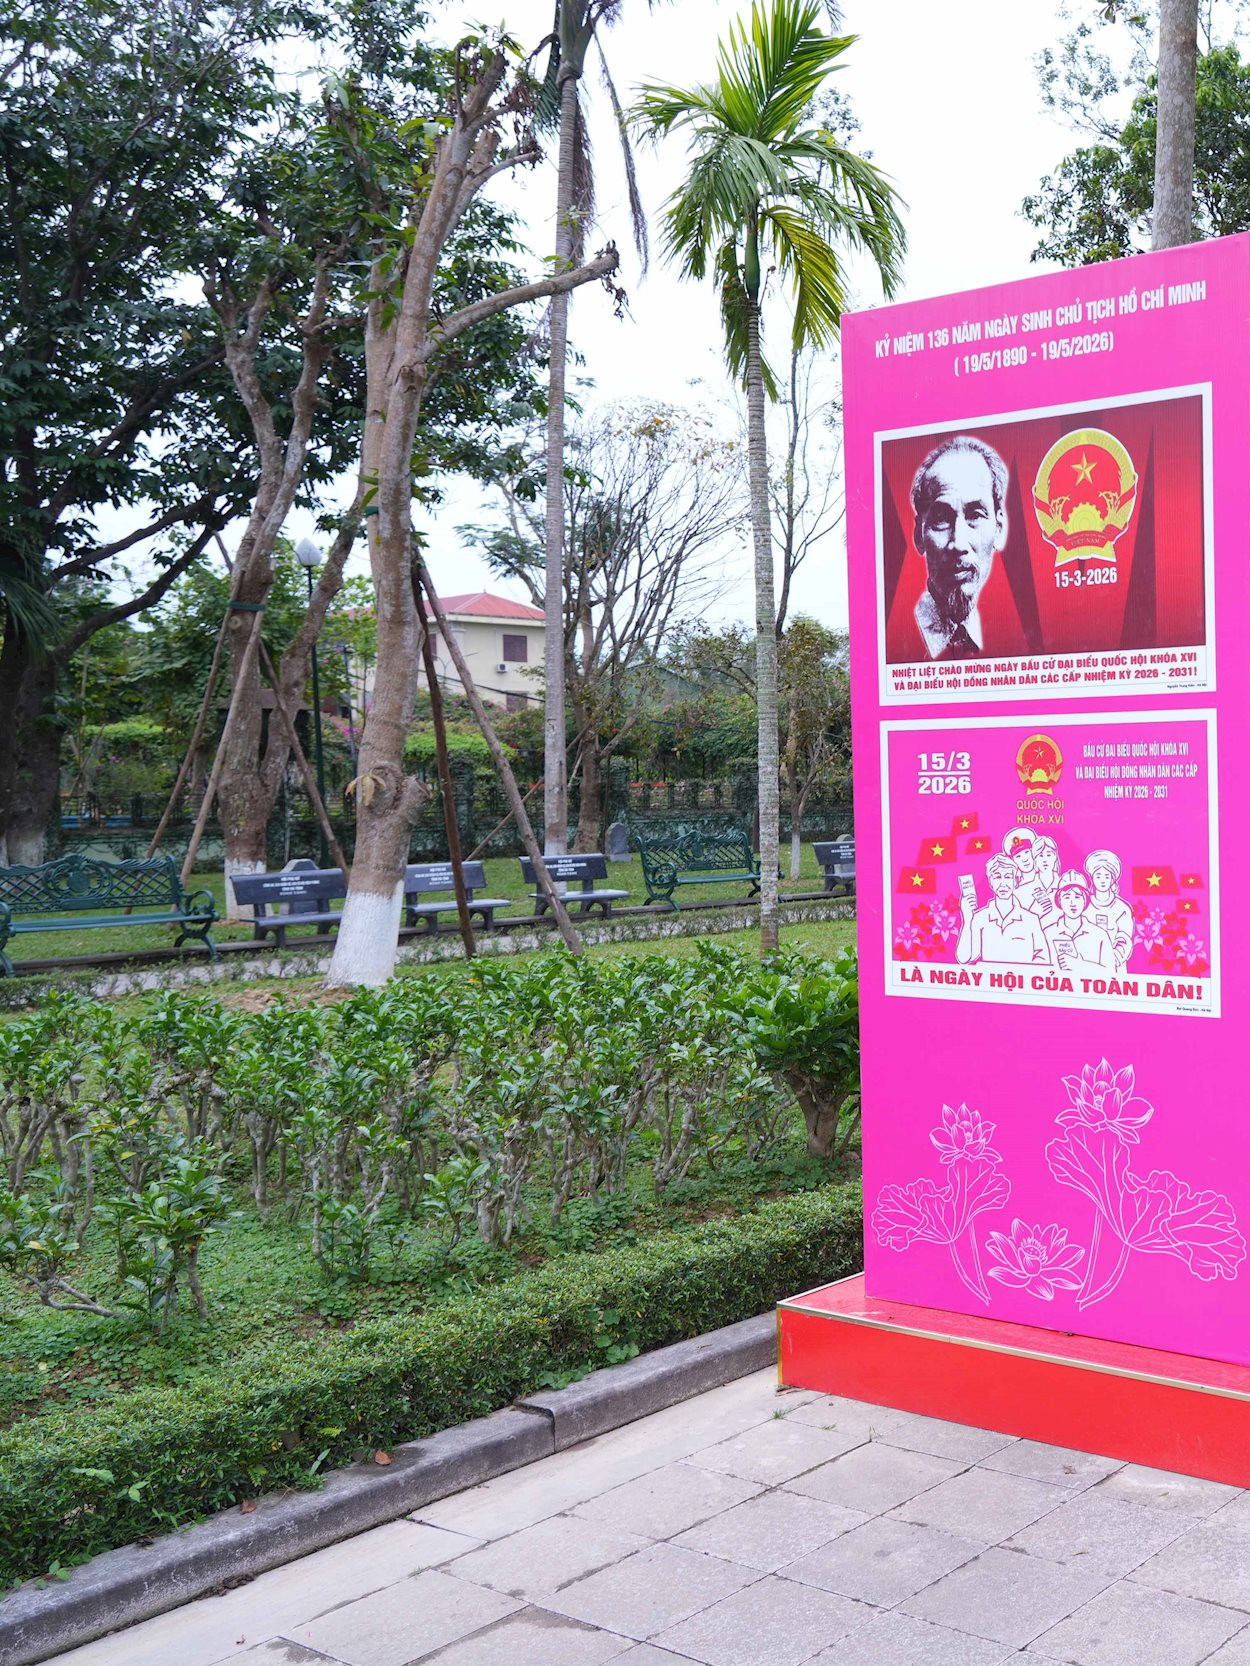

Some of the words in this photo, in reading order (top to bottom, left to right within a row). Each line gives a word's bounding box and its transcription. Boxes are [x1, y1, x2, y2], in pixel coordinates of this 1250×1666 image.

[875, 334, 890, 358] KỶ
[893, 332, 924, 357] NIỆM
[927, 328, 949, 350] 136
[952, 320, 981, 345] NĂM
[985, 314, 1017, 339] NGÀY
[1021, 309, 1052, 332] SINH
[1056, 298, 1082, 326] CHỦ
[1087, 298, 1115, 323] TỊCH
[1119, 286, 1137, 316] HỒ
[1141, 284, 1164, 311] CHÍ
[1168, 280, 1206, 307] MINH
[963, 346, 1027, 374] 19/5/1890
[1041, 331, 1114, 361] 19/5/2026)
[1055, 567, 1117, 587] 15-3-2026
[892, 668, 916, 678] NHIỆT
[919, 666, 936, 677] LIỆT
[939, 663, 962, 675] CHÀO
[965, 662, 991, 674] MỪNG
[994, 661, 1018, 672] NGÀY
[1021, 658, 1039, 671] BẦU
[1043, 657, 1056, 670] CỬ
[1058, 659, 1073, 671] ĐẠI
[1077, 654, 1098, 668] BIỂU
[1101, 653, 1127, 667] QUỐC
[1131, 654, 1147, 667] HỘI
[1150, 652, 1177, 664] KHÓA
[1181, 652, 1197, 662] XVI
[895, 680, 905, 691] VÀ
[908, 680, 921, 692] ĐẠI
[924, 677, 943, 689] BIỂU
[947, 677, 961, 690] HỘI
[964, 675, 987, 688] ĐỒNG
[991, 675, 1016, 686] NHÂN
[1019, 674, 1038, 684] DÂN
[1041, 672, 1059, 683] CÁC
[1063, 669, 1081, 683] CẤP
[1084, 670, 1116, 683] NHIỆM
[1119, 668, 1131, 680] KỲ
[1135, 669, 1158, 679] 2026
[1169, 666, 1197, 677] 2031!
[1083, 741, 1095, 758] BẦU
[1096, 740, 1105, 757] CỬ
[1106, 744, 1116, 760] ĐẠI
[1117, 739, 1130, 756] BIỂU
[1132, 741, 1148, 758] QUỐC
[1149, 740, 1160, 759] HỘI
[1161, 740, 1177, 756] KHÓA
[1179, 742, 1188, 756] XVI
[917, 751, 971, 771] 15/3
[1076, 763, 1084, 779] VÀ
[1085, 766, 1094, 781] ĐẠI
[1096, 761, 1109, 778] BIỂU
[1110, 763, 1120, 782] HỘI
[1122, 761, 1138, 778] ĐỒNG
[1139, 762, 1156, 778] NHÂN
[1158, 762, 1170, 778] DÂN
[1172, 762, 1184, 778] CÁC
[1186, 760, 1198, 777] CẤP
[918, 776, 972, 794] 2026
[1104, 783, 1123, 801] NHIỆM
[1125, 783, 1132, 798] KỲ
[1134, 786, 1148, 798] 2026
[1154, 785, 1168, 798] 2031
[1016, 798, 1044, 810] QUỐC
[1048, 798, 1064, 812] HỘI
[1017, 812, 1045, 824] KHÓA
[1049, 814, 1064, 824] XVI
[900, 966, 923, 983] LÀ
[930, 968, 982, 987] NGÀY
[990, 971, 1023, 991] HỘI
[1031, 970, 1074, 992] CỦA
[1080, 977, 1138, 997] TOÀN
[1147, 979, 1202, 1000] DÂN!
